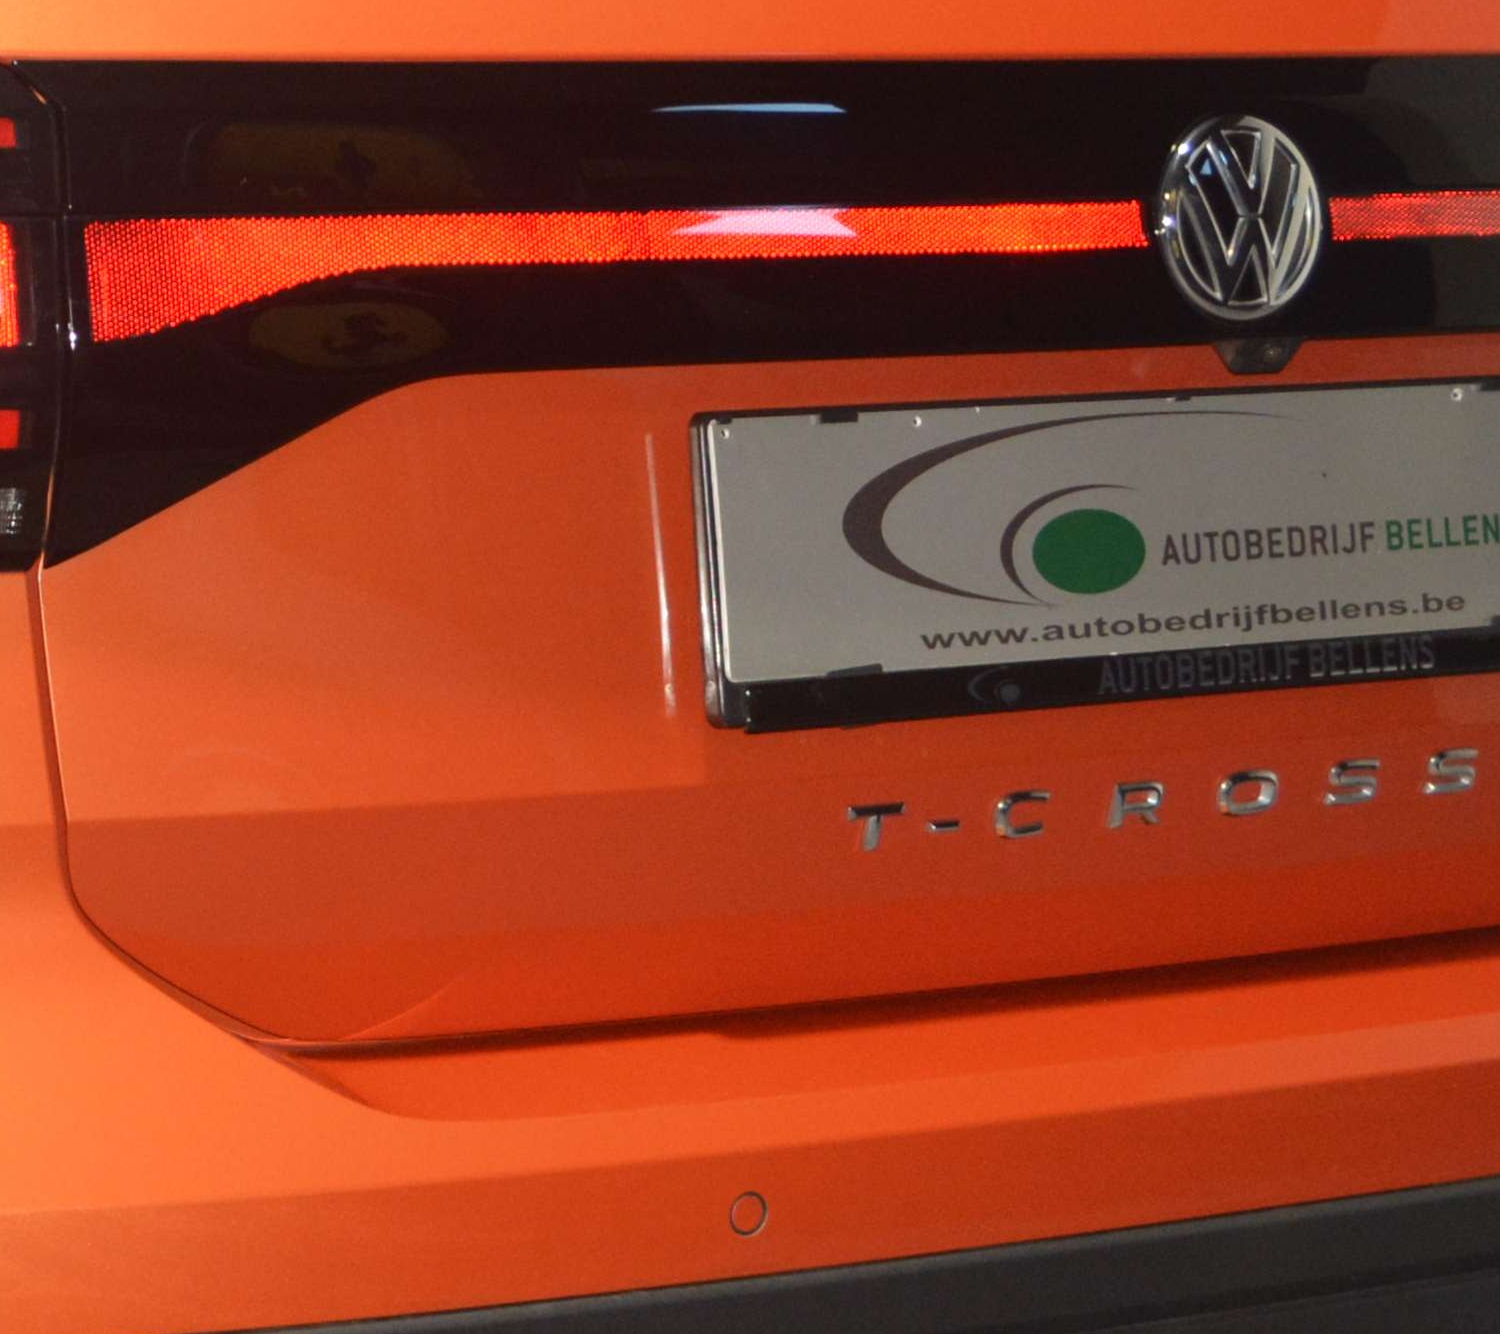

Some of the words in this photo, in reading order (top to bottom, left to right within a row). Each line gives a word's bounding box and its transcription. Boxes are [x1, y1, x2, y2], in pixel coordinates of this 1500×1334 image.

[1160, 115, 1322, 320] VW
[1161, 521, 1375, 566] AUTOBEDRIJF
[920, 592, 1466, 650] www.autobedrijfbellens.be
[1097, 641, 1303, 696] AUTOBEDRIJF
[1309, 633, 1436, 678] BELLENS
[847, 747, 1479, 852] T-CROSS
